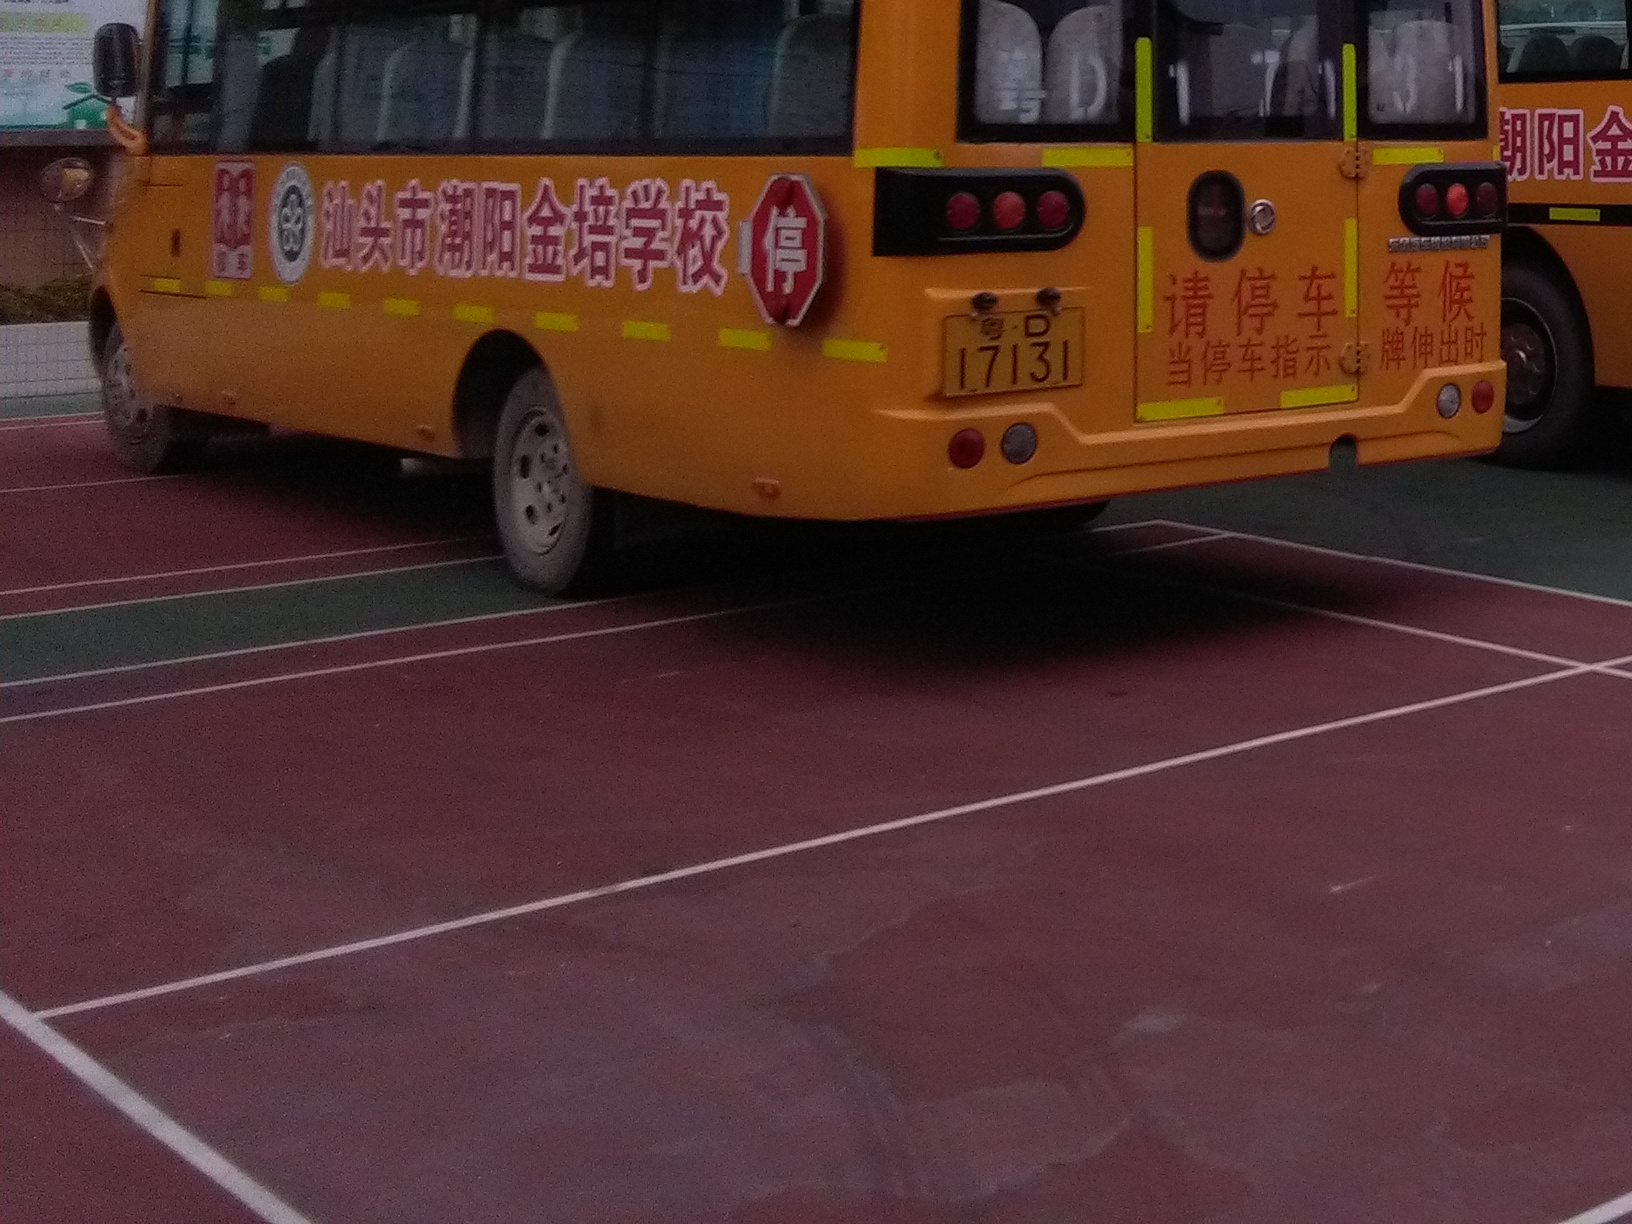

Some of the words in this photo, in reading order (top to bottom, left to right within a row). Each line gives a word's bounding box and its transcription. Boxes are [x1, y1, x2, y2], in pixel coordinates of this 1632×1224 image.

[320, 178, 728, 294] 汕头市潮阳金培学校
[766, 207, 808, 294] 停
[959, 339, 1069, 389] 17131
